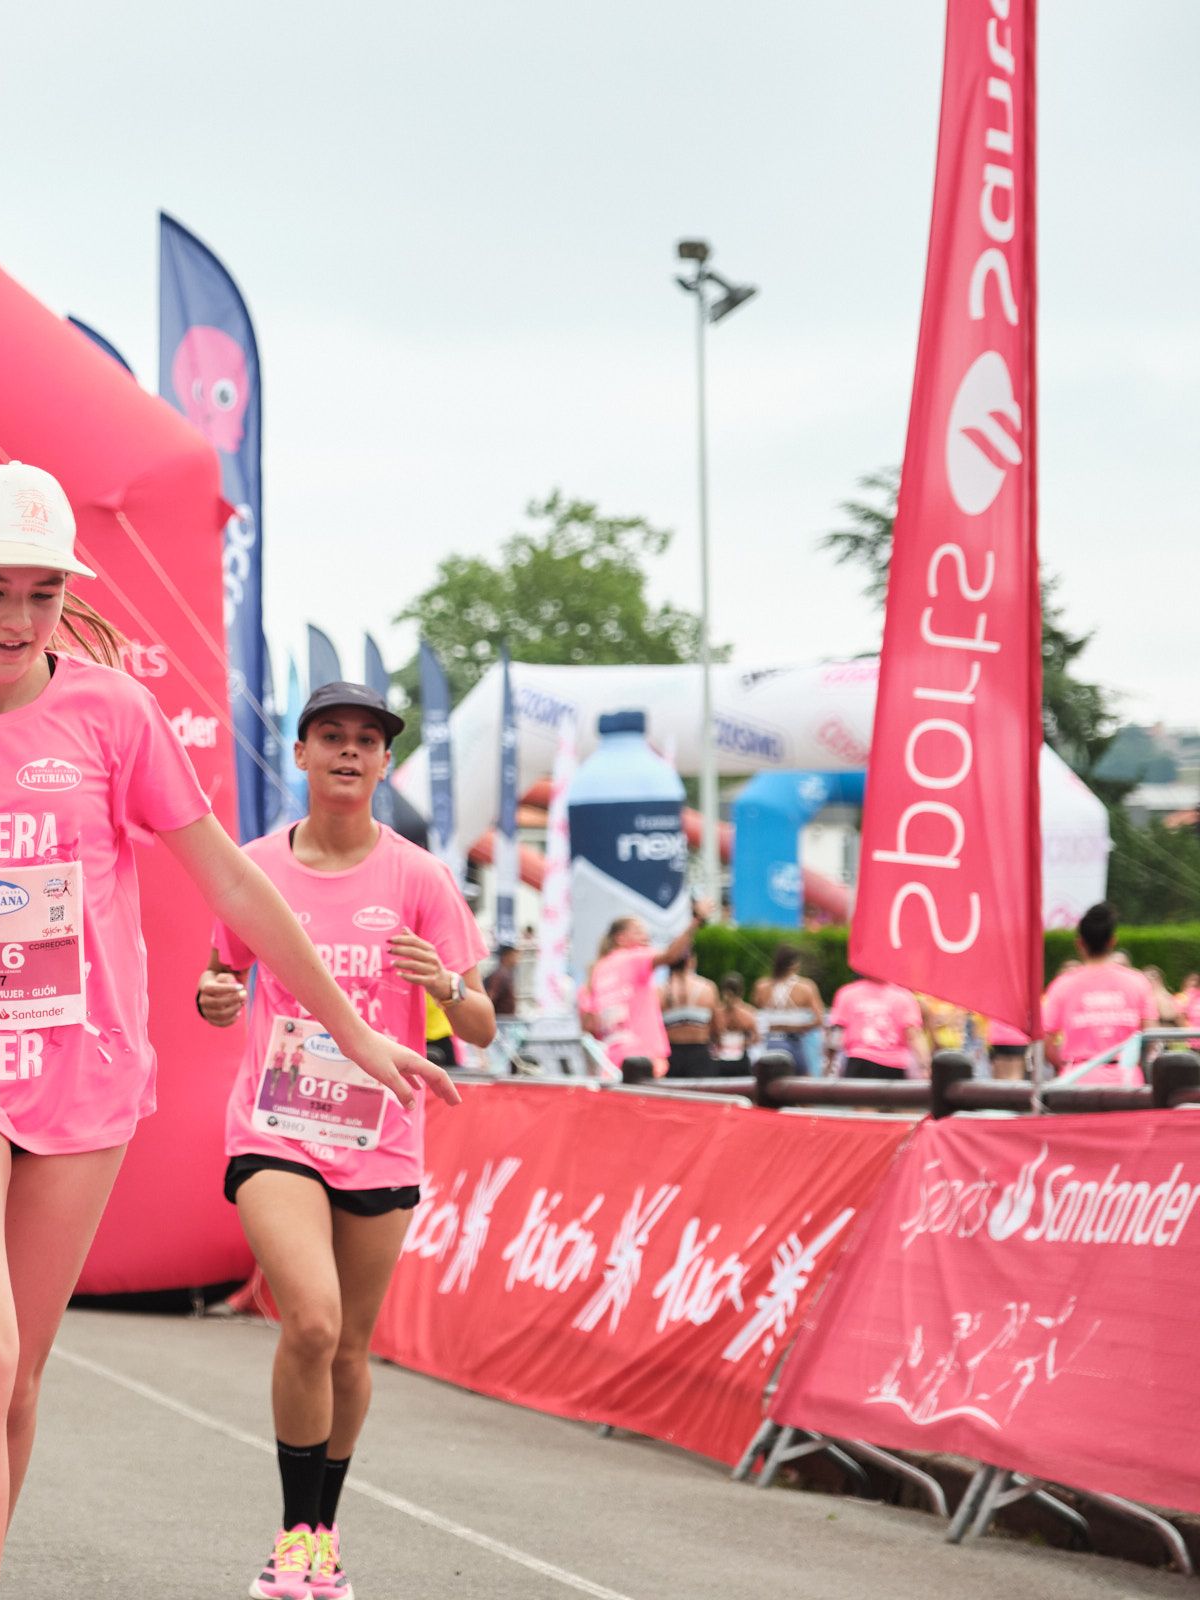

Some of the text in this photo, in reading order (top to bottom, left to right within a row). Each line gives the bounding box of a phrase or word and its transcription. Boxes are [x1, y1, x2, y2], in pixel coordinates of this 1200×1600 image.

[21, 770, 78, 784] ASTURIANA
[32, 984, 57, 997] GIJÓN
[12, 1007, 64, 1020] Santander
[298, 1076, 349, 1102] 016
[1023, 1161, 1200, 1247] Santander
